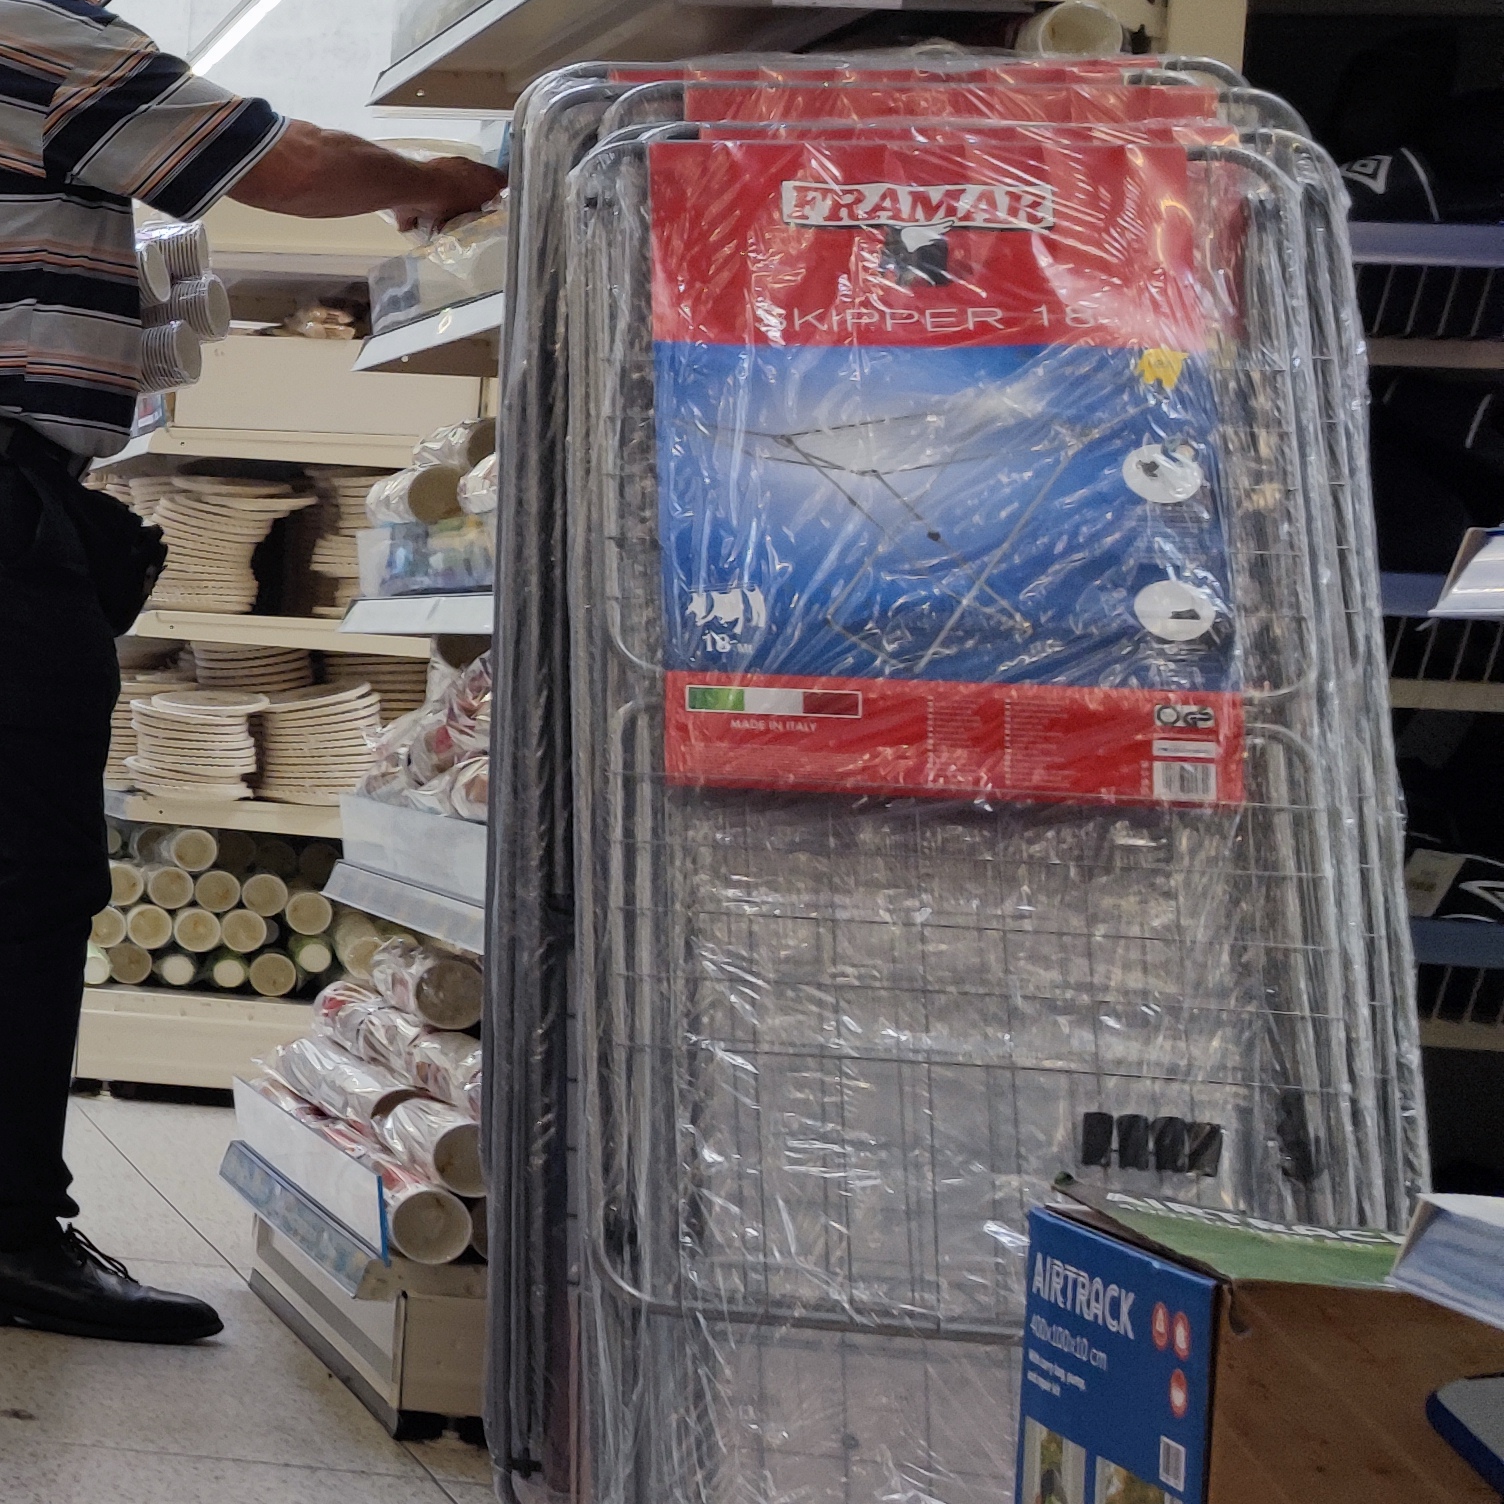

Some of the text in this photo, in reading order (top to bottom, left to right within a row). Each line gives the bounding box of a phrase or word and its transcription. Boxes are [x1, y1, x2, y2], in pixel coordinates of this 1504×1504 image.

[787, 186, 1050, 226] FRAMAR
[730, 719, 766, 731] MADE
[1032, 1251, 1135, 1340] AIRTRACK
